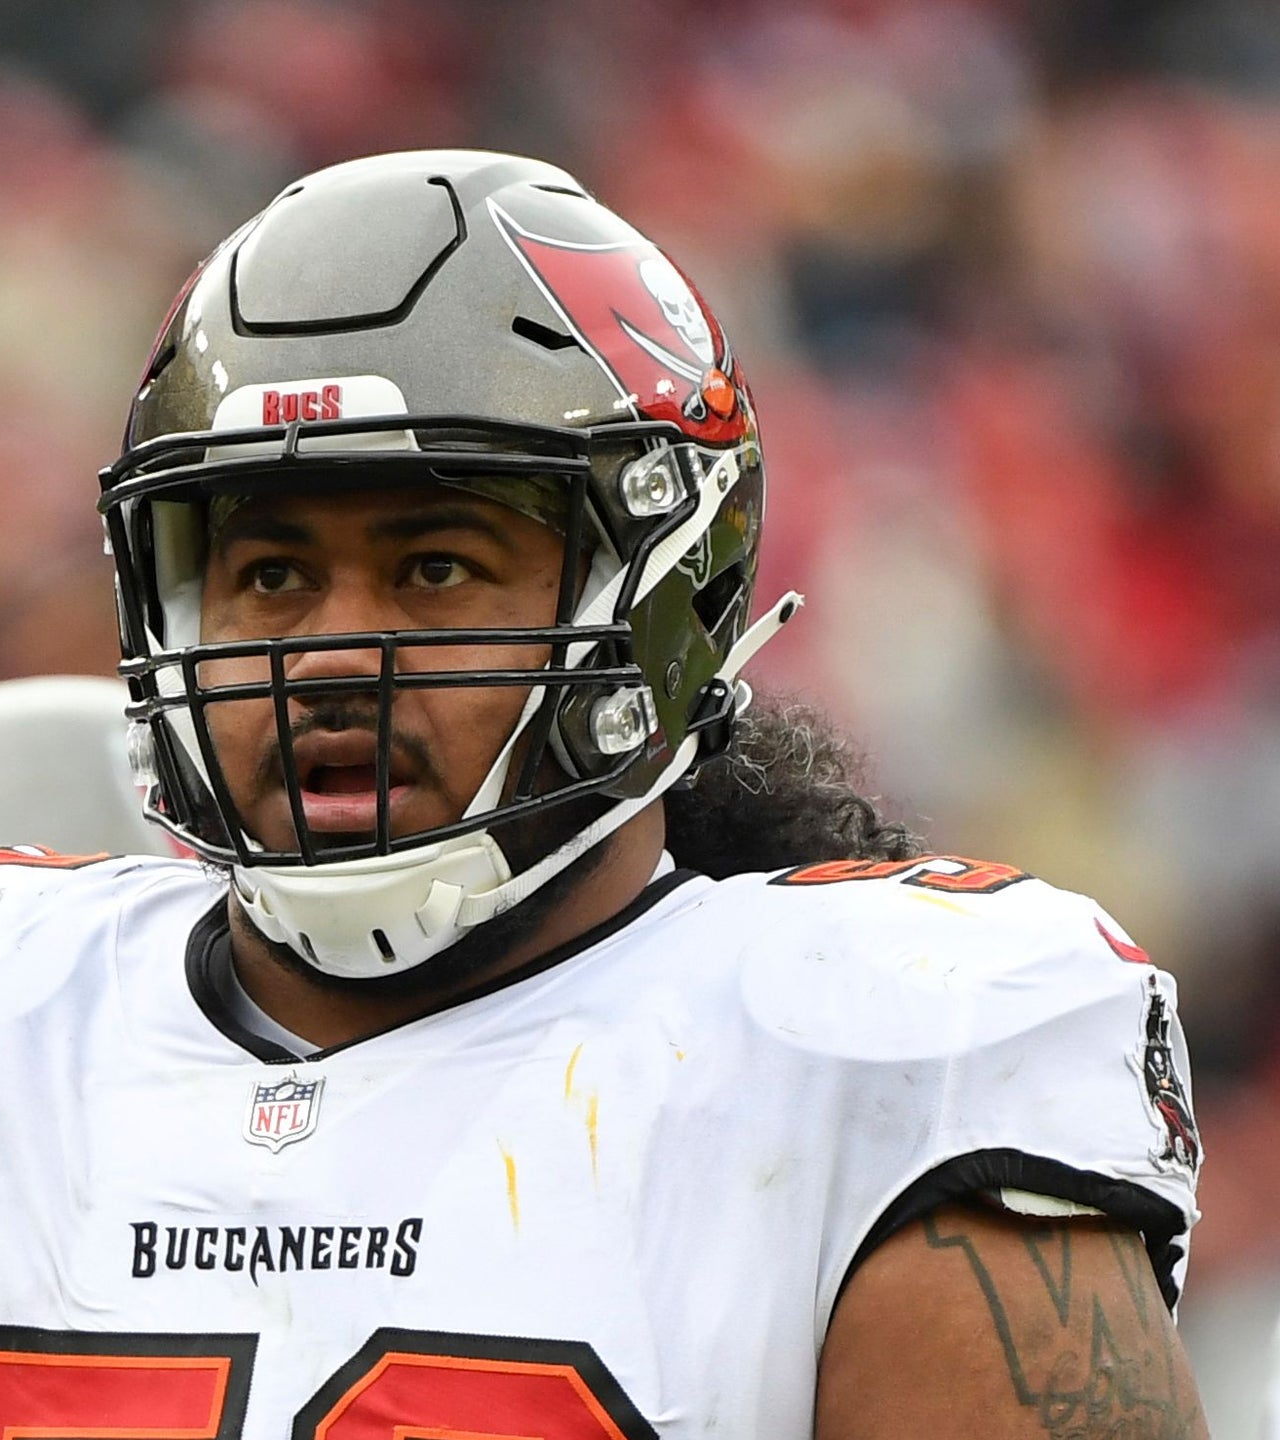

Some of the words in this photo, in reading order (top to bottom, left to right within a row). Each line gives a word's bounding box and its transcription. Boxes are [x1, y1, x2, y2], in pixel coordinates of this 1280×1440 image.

[262, 384, 341, 426] BUCS
[255, 1103, 303, 1135] NFL
[128, 1218, 424, 1287] BUCCANEERS
